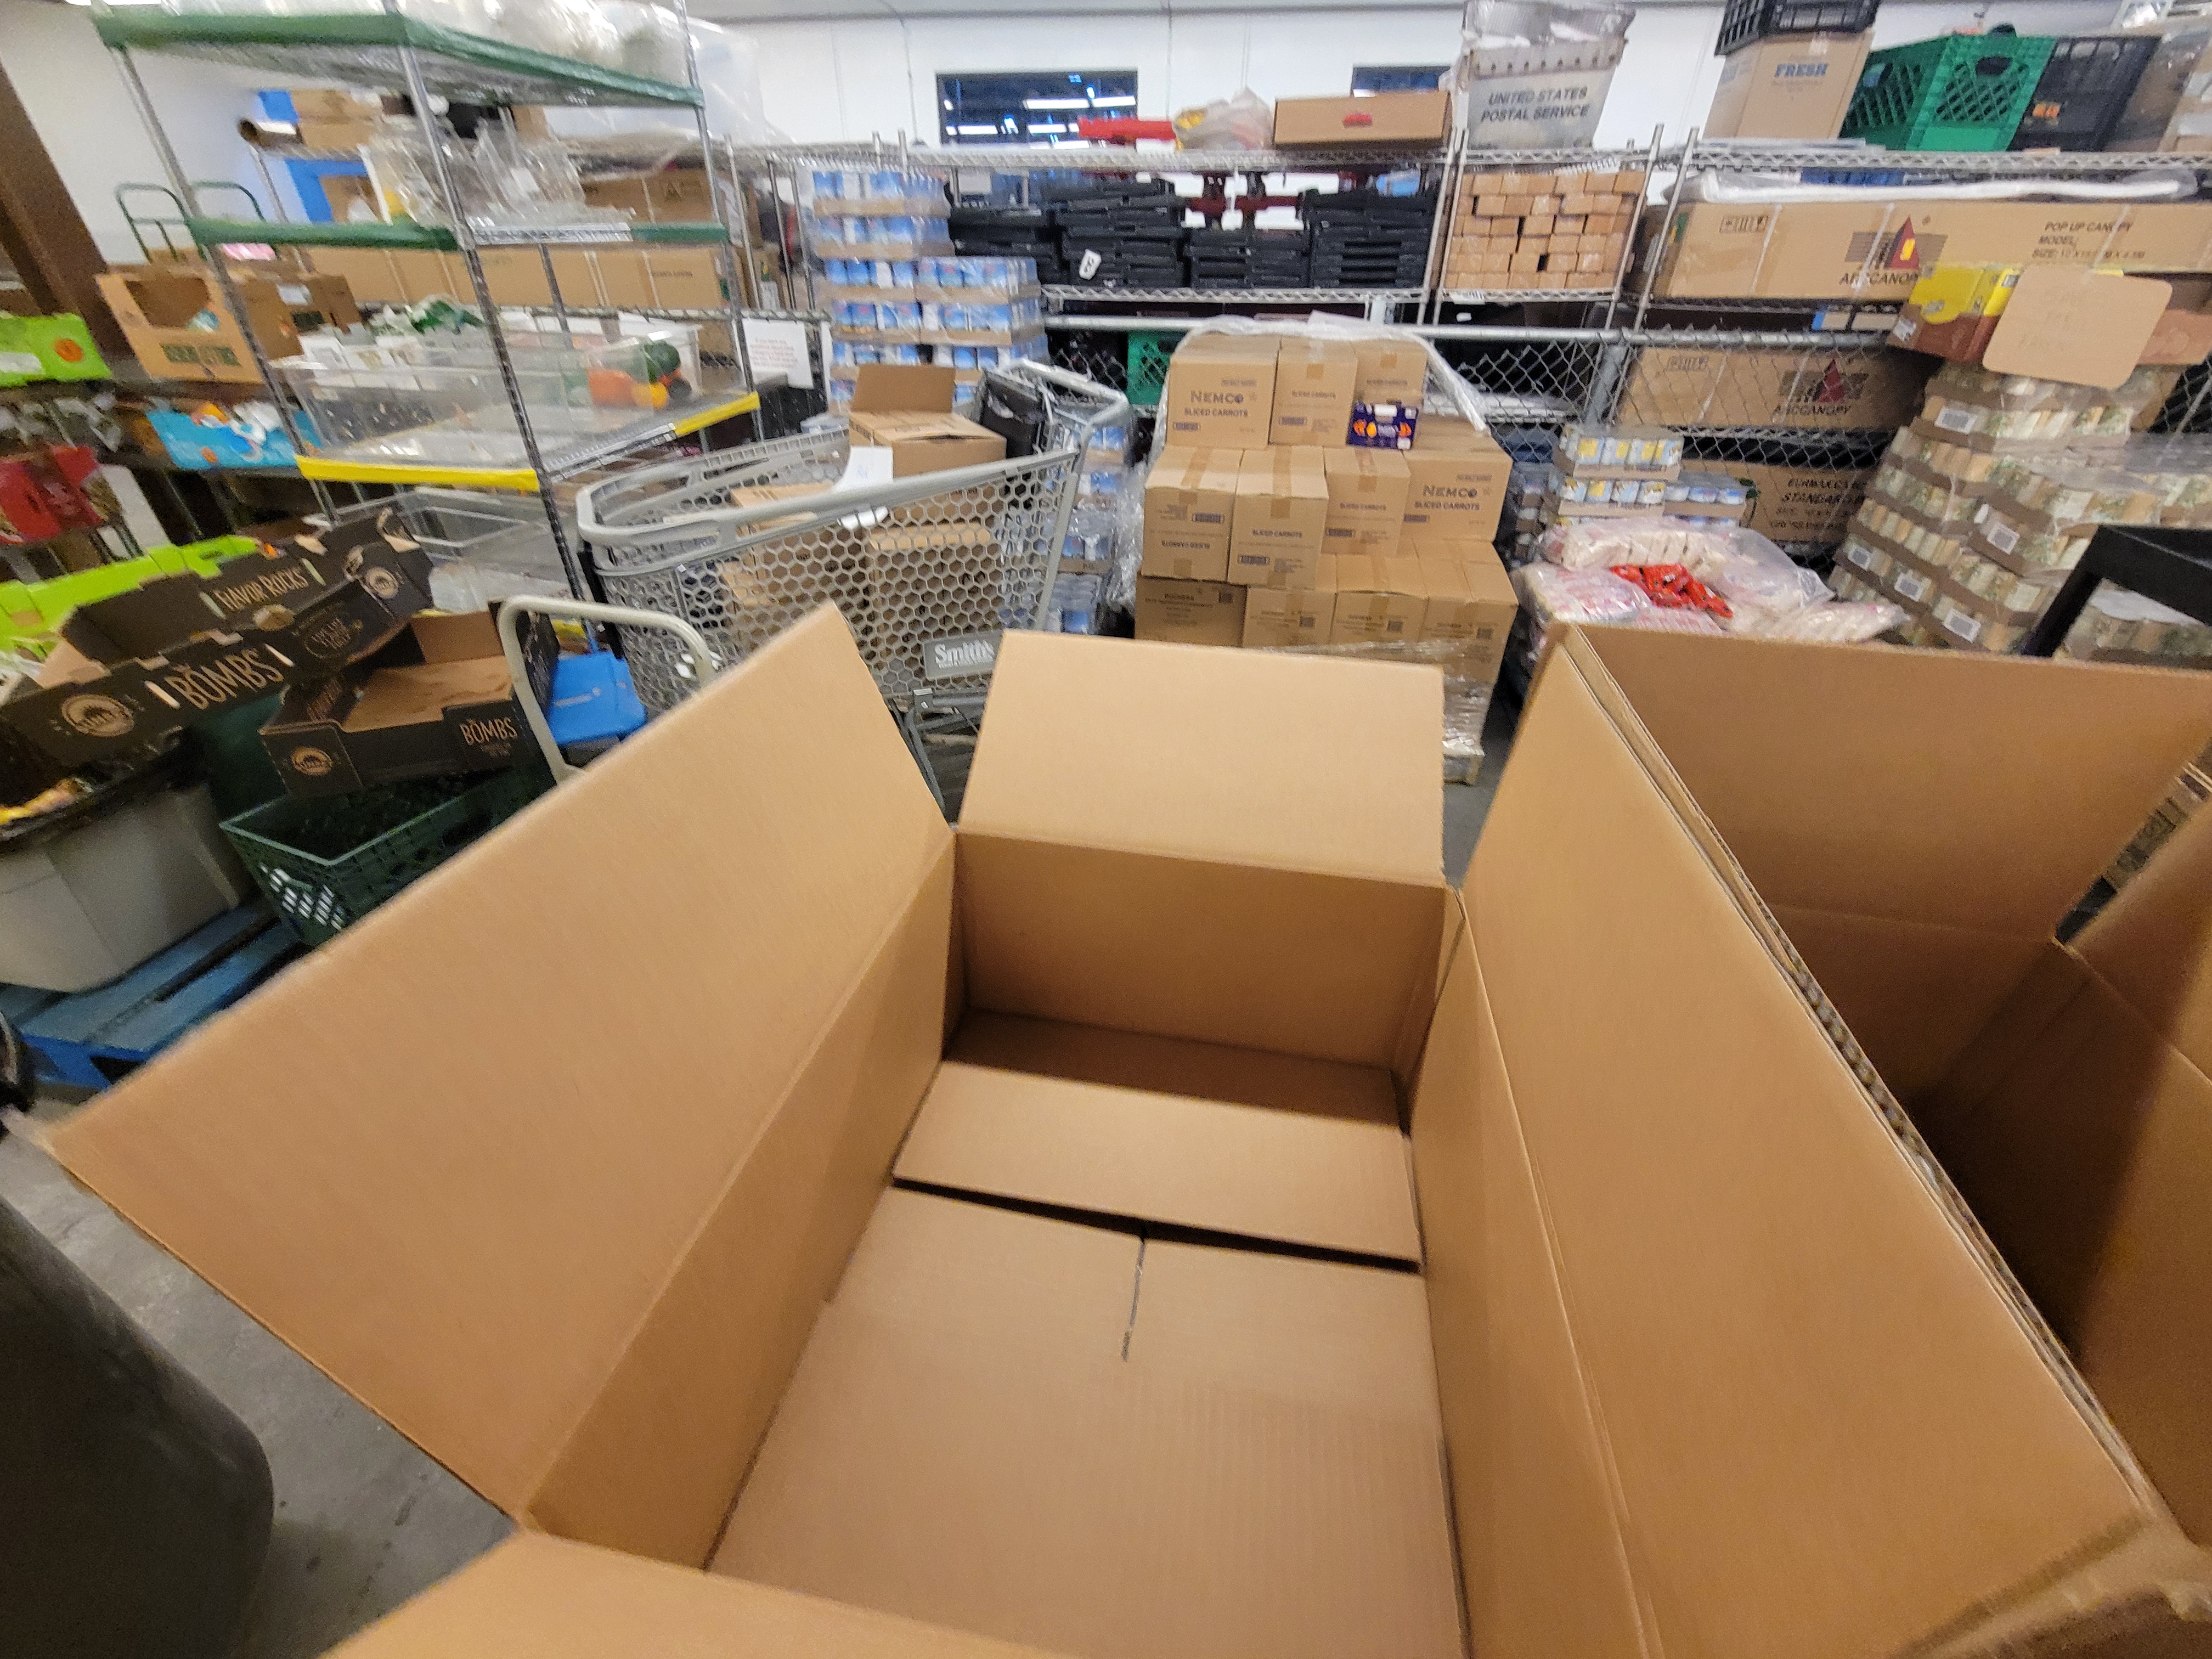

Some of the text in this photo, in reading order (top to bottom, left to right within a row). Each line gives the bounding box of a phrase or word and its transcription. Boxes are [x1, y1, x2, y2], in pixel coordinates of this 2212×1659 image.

[1774, 63, 1828, 77] FRESH
[1489, 87, 1588, 104] UNITED STATES
[1481, 104, 1589, 121] POSTAL SERVICE
[2045, 221, 2068, 231] POP
[2069, 222, 2084, 232] UP
[1184, 408, 1248, 417] SLICED CARROTS
[213, 567, 309, 611] FLAVOR ROCKS
[165, 648, 284, 709] BOMBS
[460, 716, 518, 745] BOMBS
